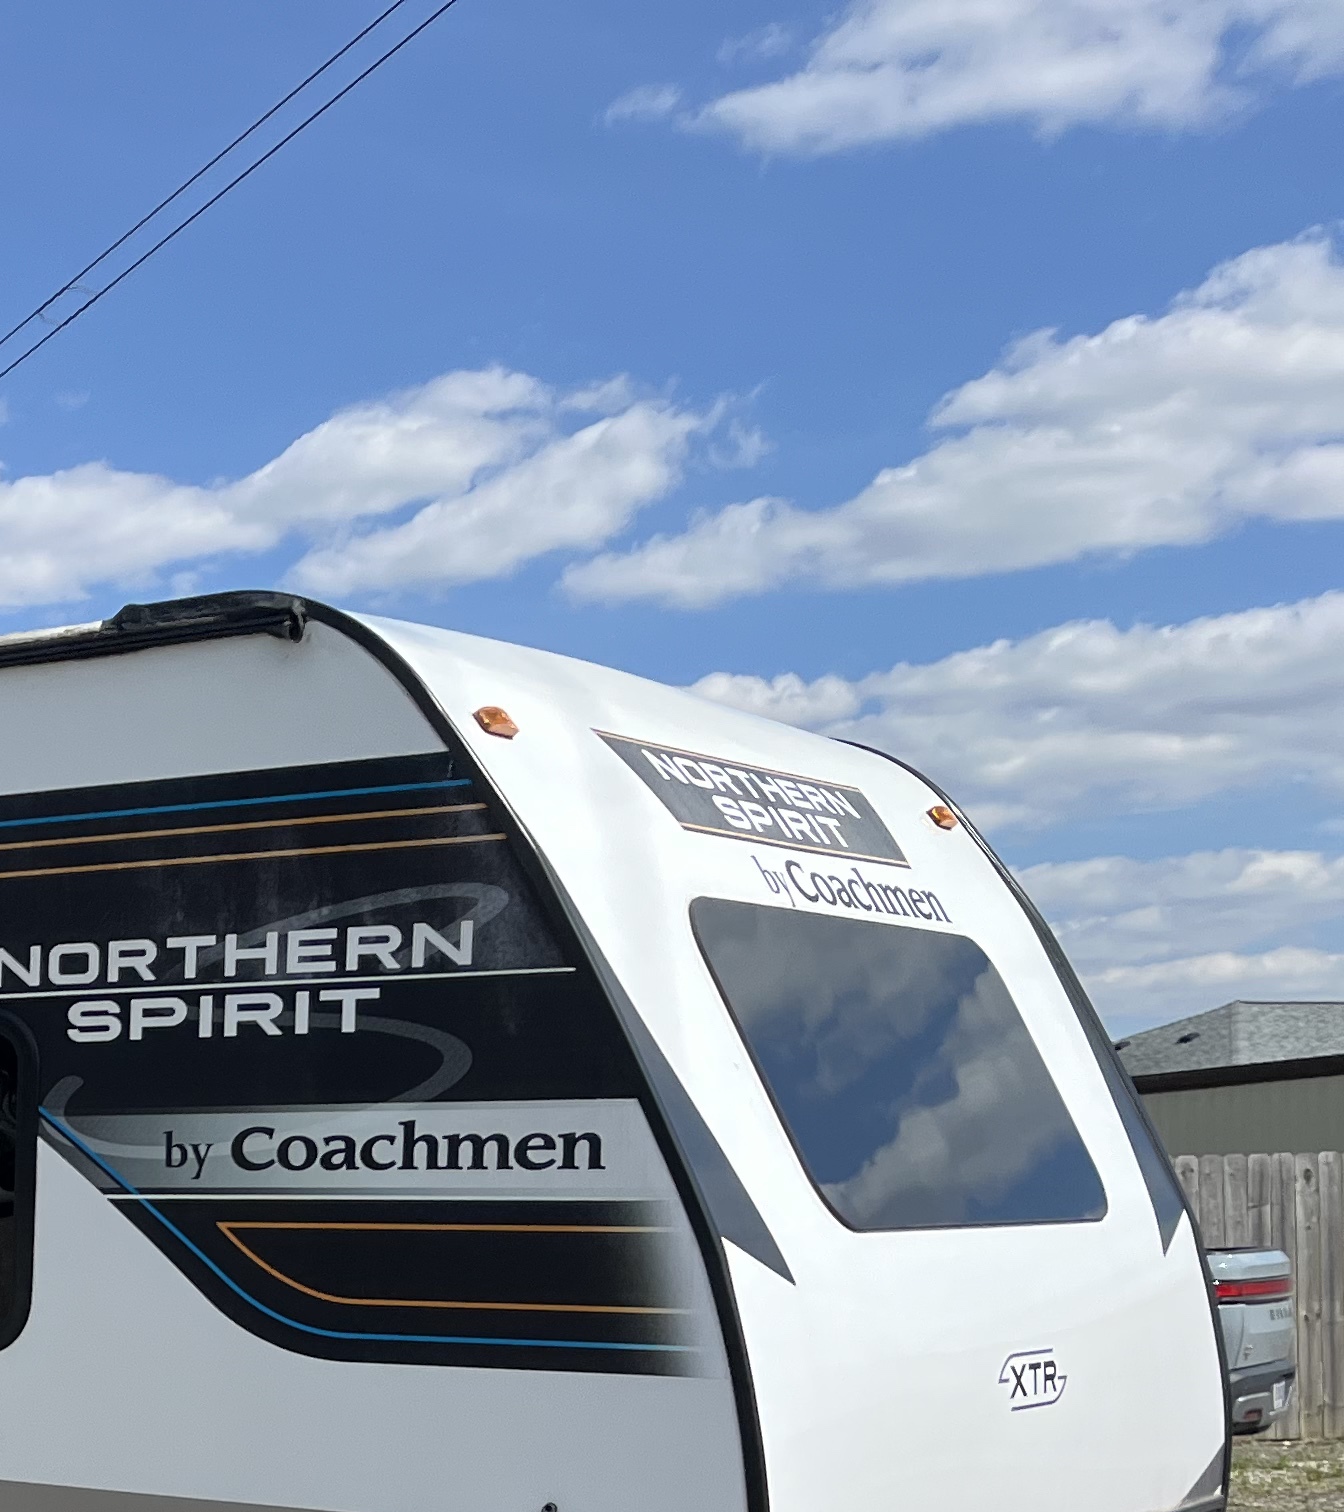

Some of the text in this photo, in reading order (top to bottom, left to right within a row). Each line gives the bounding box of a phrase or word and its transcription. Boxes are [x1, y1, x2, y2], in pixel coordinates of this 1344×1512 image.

[641, 748, 862, 820] NORTHERN
[712, 794, 849, 848] SPIRIT
[750, 854, 953, 923] by Coachmen
[66, 987, 381, 1043] SPIRIT
[163, 1119, 606, 1180] by Coachmen
[1010, 1360, 1057, 1399] XTR
